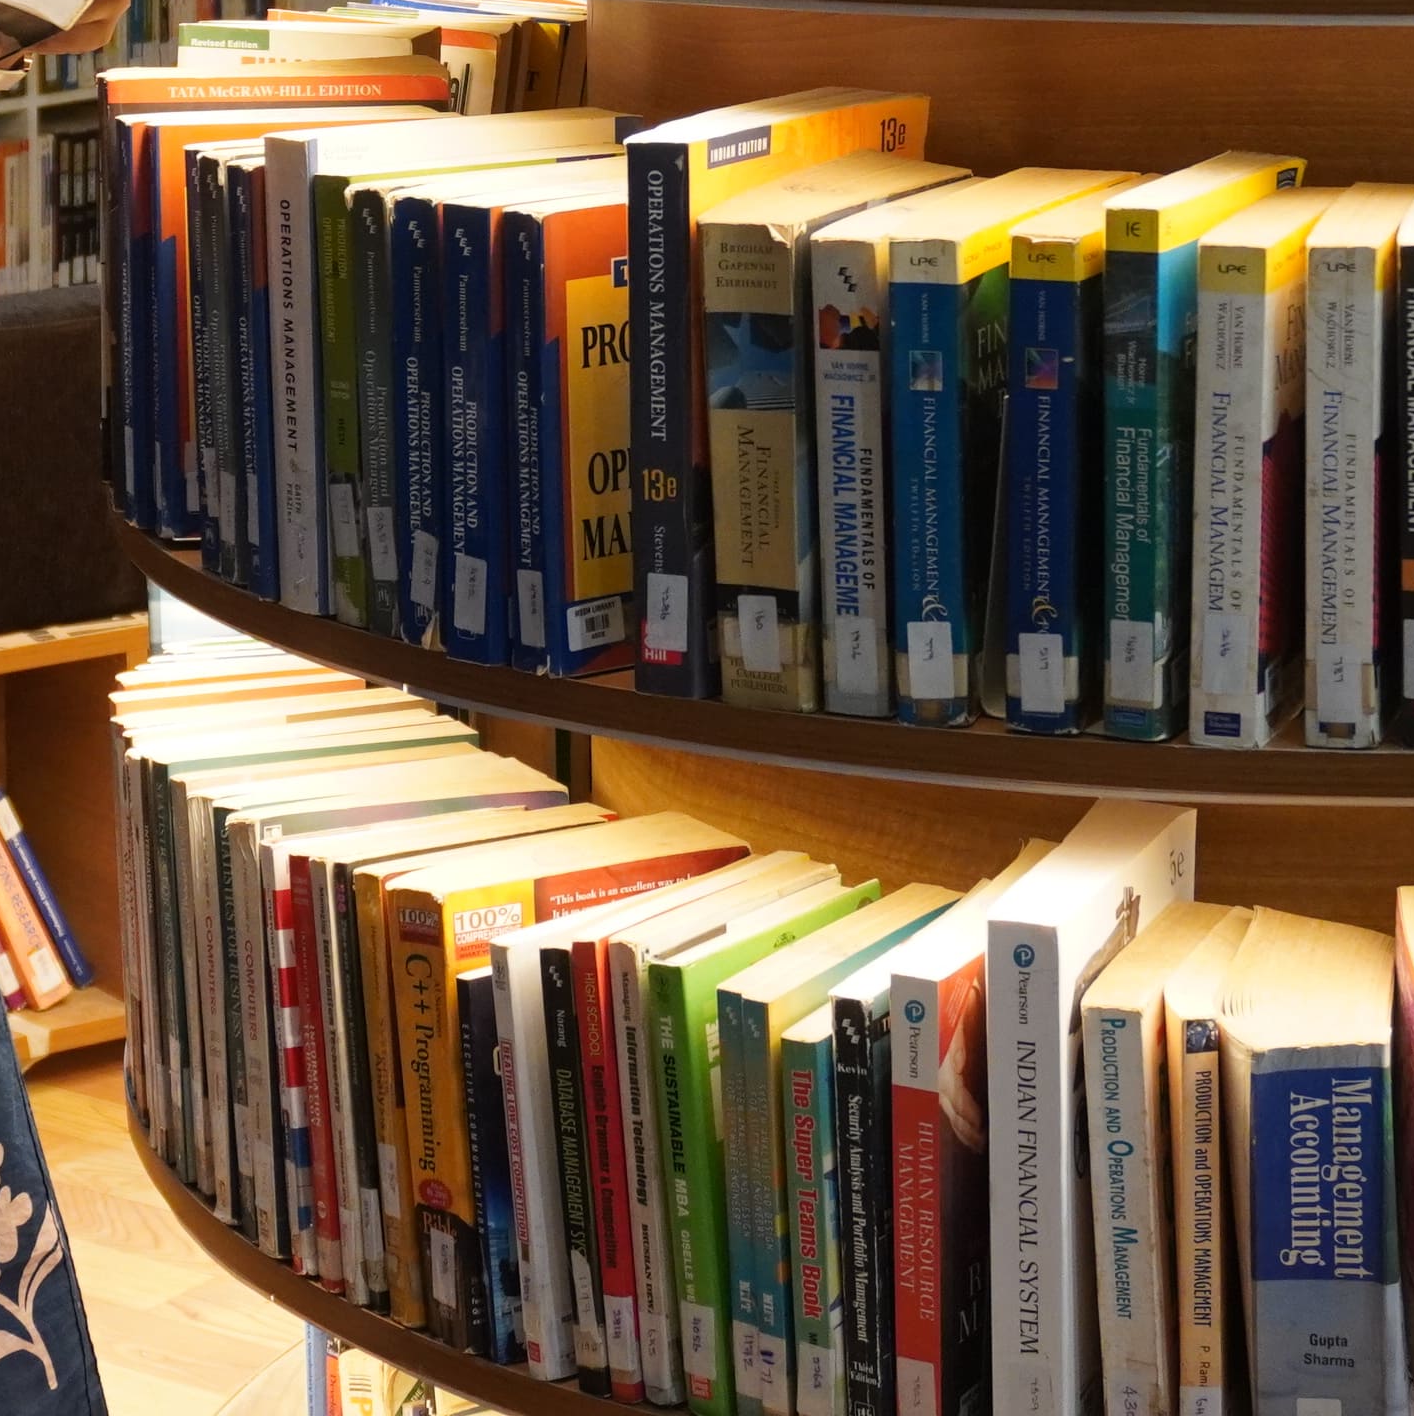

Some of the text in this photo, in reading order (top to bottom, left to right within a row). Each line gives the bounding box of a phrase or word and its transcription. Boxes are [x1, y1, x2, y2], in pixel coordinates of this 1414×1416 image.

[168, 83, 382, 98] TATA McGRAW-HILL EDITION
[280, 200, 298, 454] OPERATIONS MANAGEMENT
[648, 169, 667, 441] OPERATIONS MANAGEMENT
[643, 468, 676, 501] 13e
[454, 903, 522, 934] 100%
[406, 953, 439, 1174] C++ Programming
[626, 1026, 648, 1206] Information Technology
[660, 1016, 689, 1217] THE SUSTAINABLE MBA
[792, 1070, 820, 1318] The Super Teams Book
[1017, 1041, 1039, 1355] INDIAN FINANCIAL SYSTEM
[1193, 1070, 1212, 1327] PRODUCTION and OPERATIONS MANAGEMENT
[1280, 1094, 1324, 1266] Accounting
[1321, 1078, 1373, 1279] Management
[1303, 1353, 1354, 1368] Sharma
[1309, 1333, 1348, 1350] Gupta
